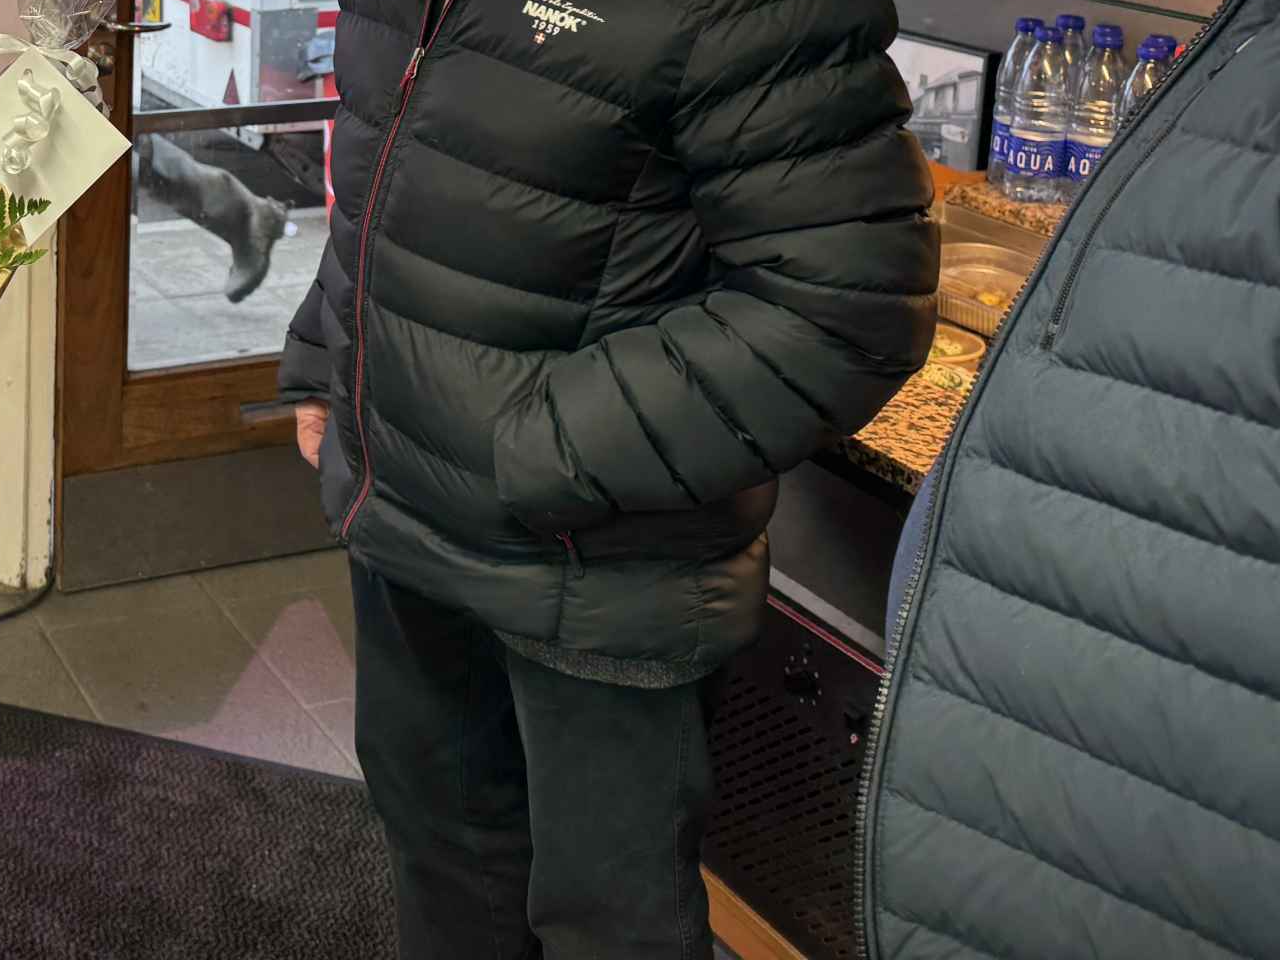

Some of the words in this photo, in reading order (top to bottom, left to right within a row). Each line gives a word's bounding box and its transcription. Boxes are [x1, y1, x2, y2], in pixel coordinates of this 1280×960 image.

[531, 19, 561, 36] 1959
[1007, 149, 1054, 172] AQUA
[1067, 155, 1090, 176] AQ
